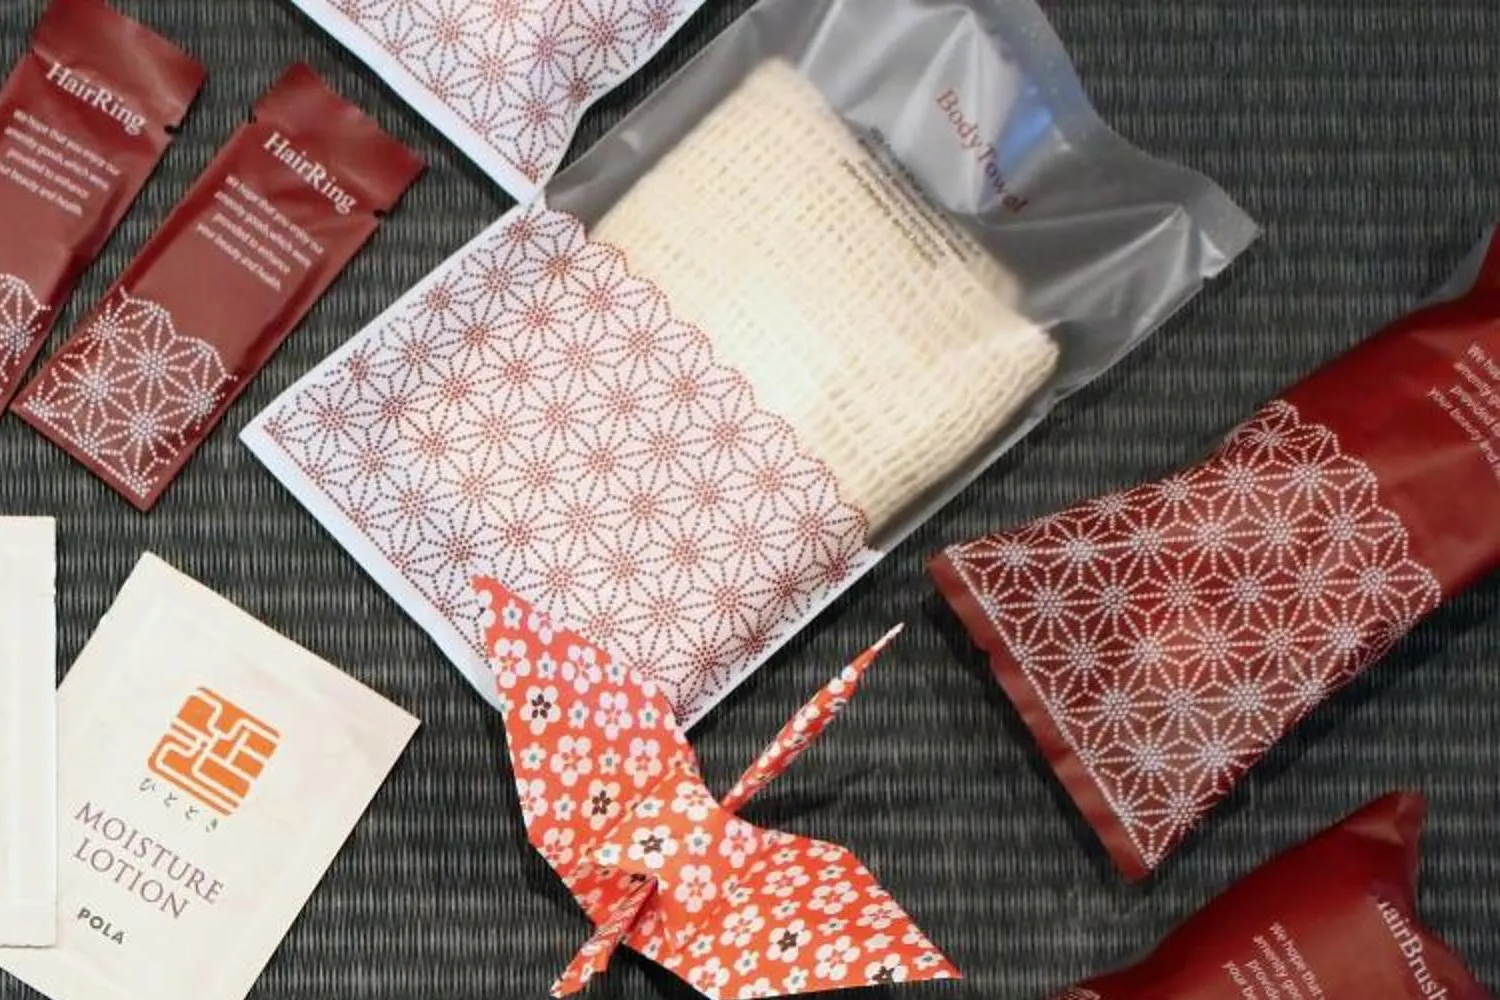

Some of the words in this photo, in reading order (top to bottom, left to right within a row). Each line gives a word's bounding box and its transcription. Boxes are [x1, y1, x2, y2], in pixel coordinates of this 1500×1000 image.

[46, 63, 146, 136] HairRing
[264, 132, 358, 216] HairRing
[73, 837, 190, 919] LOTION
[74, 801, 224, 904] MOISTURE
[77, 906, 125, 944] POLA
[1223, 961, 1248, 987] your
[1283, 940, 1307, 972] hope
[1301, 970, 1323, 997] that
